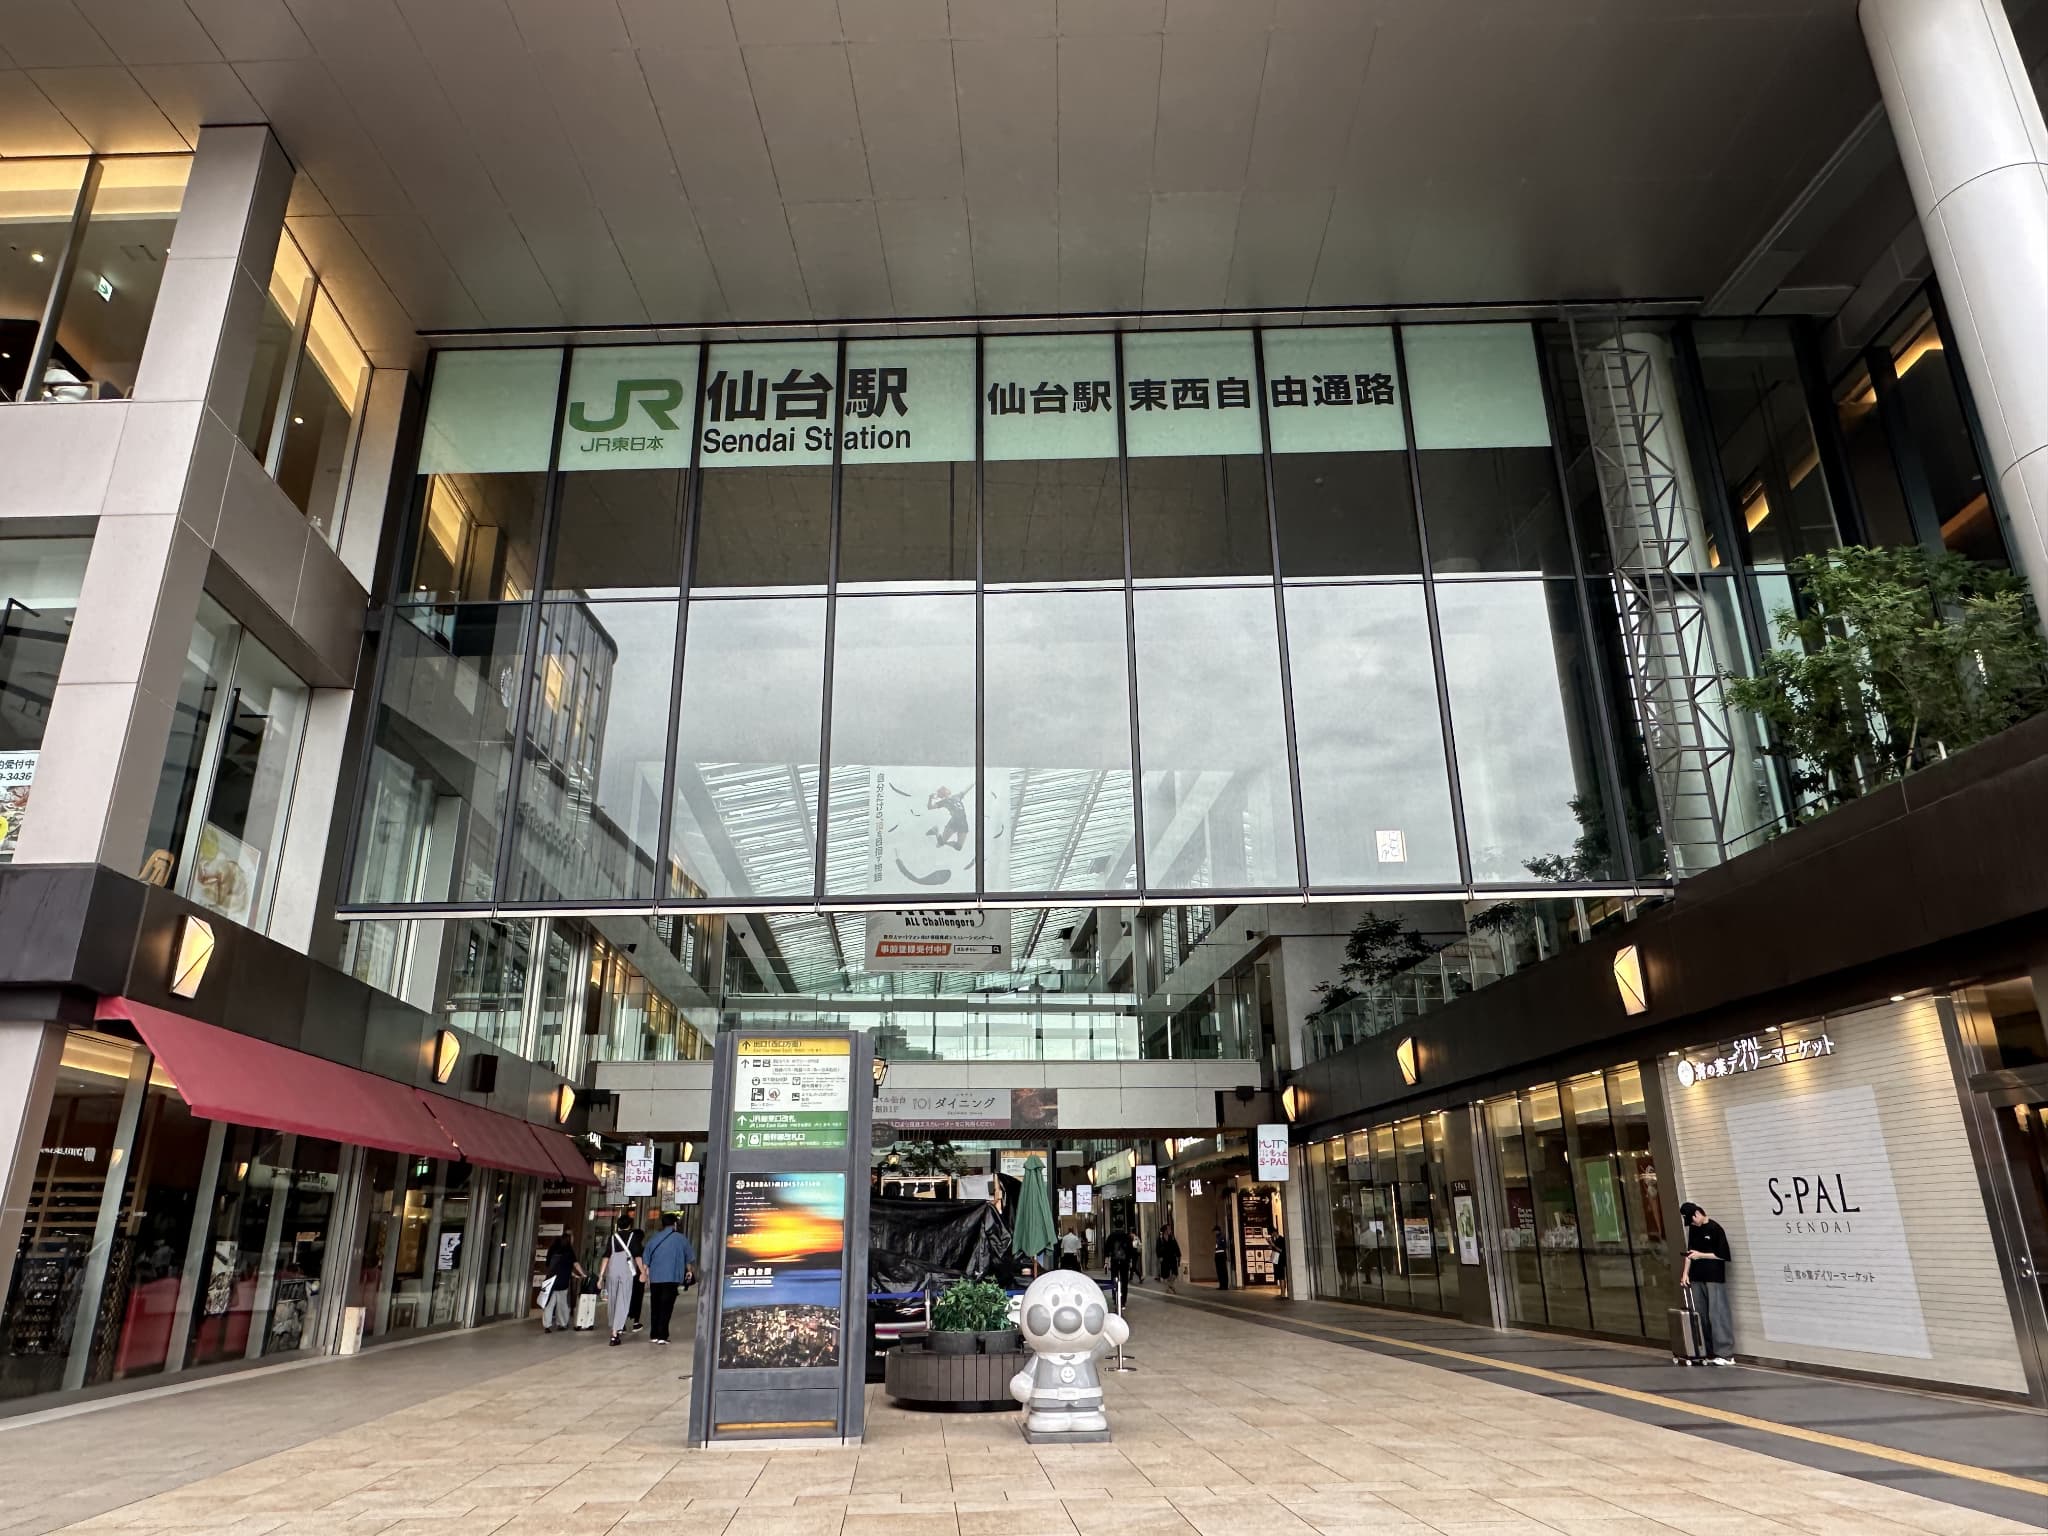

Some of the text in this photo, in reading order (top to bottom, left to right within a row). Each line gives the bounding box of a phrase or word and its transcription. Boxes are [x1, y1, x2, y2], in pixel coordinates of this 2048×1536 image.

[569, 378, 684, 433] JR
[707, 367, 909, 422] 仙台駅
[580, 435, 664, 453] JR東日本
[703, 425, 911, 454] Sendai Station
[935, 1097, 996, 1109] ダイニング
[1259, 1158, 1288, 1166] S-PAL
[1768, 1173, 1861, 1216] S-PAL
[1785, 1221, 1853, 1234] SENDAI
